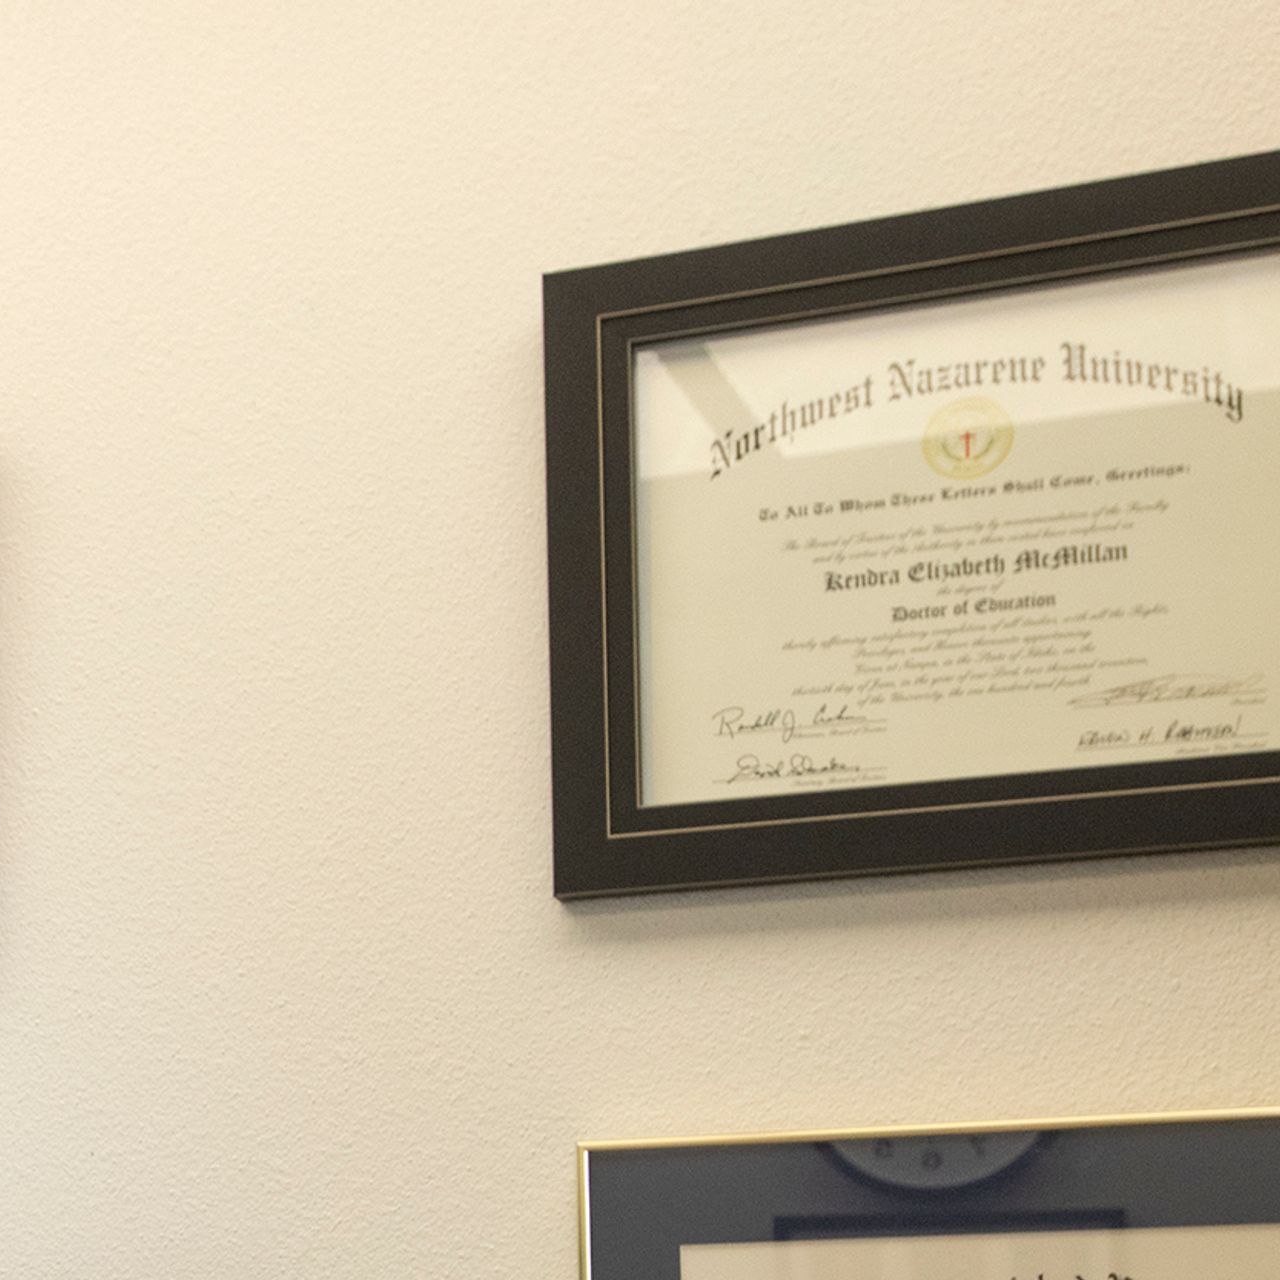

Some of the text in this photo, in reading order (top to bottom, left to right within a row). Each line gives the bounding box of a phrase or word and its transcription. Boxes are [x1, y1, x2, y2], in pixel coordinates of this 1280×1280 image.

[709, 341, 1244, 482] Northwest Nazarene University
[824, 568, 901, 592] Kendra
[907, 554, 1006, 583] Elizabeth
[1013, 543, 1128, 575] McMillan
[891, 593, 1057, 622] Doctor of Education
